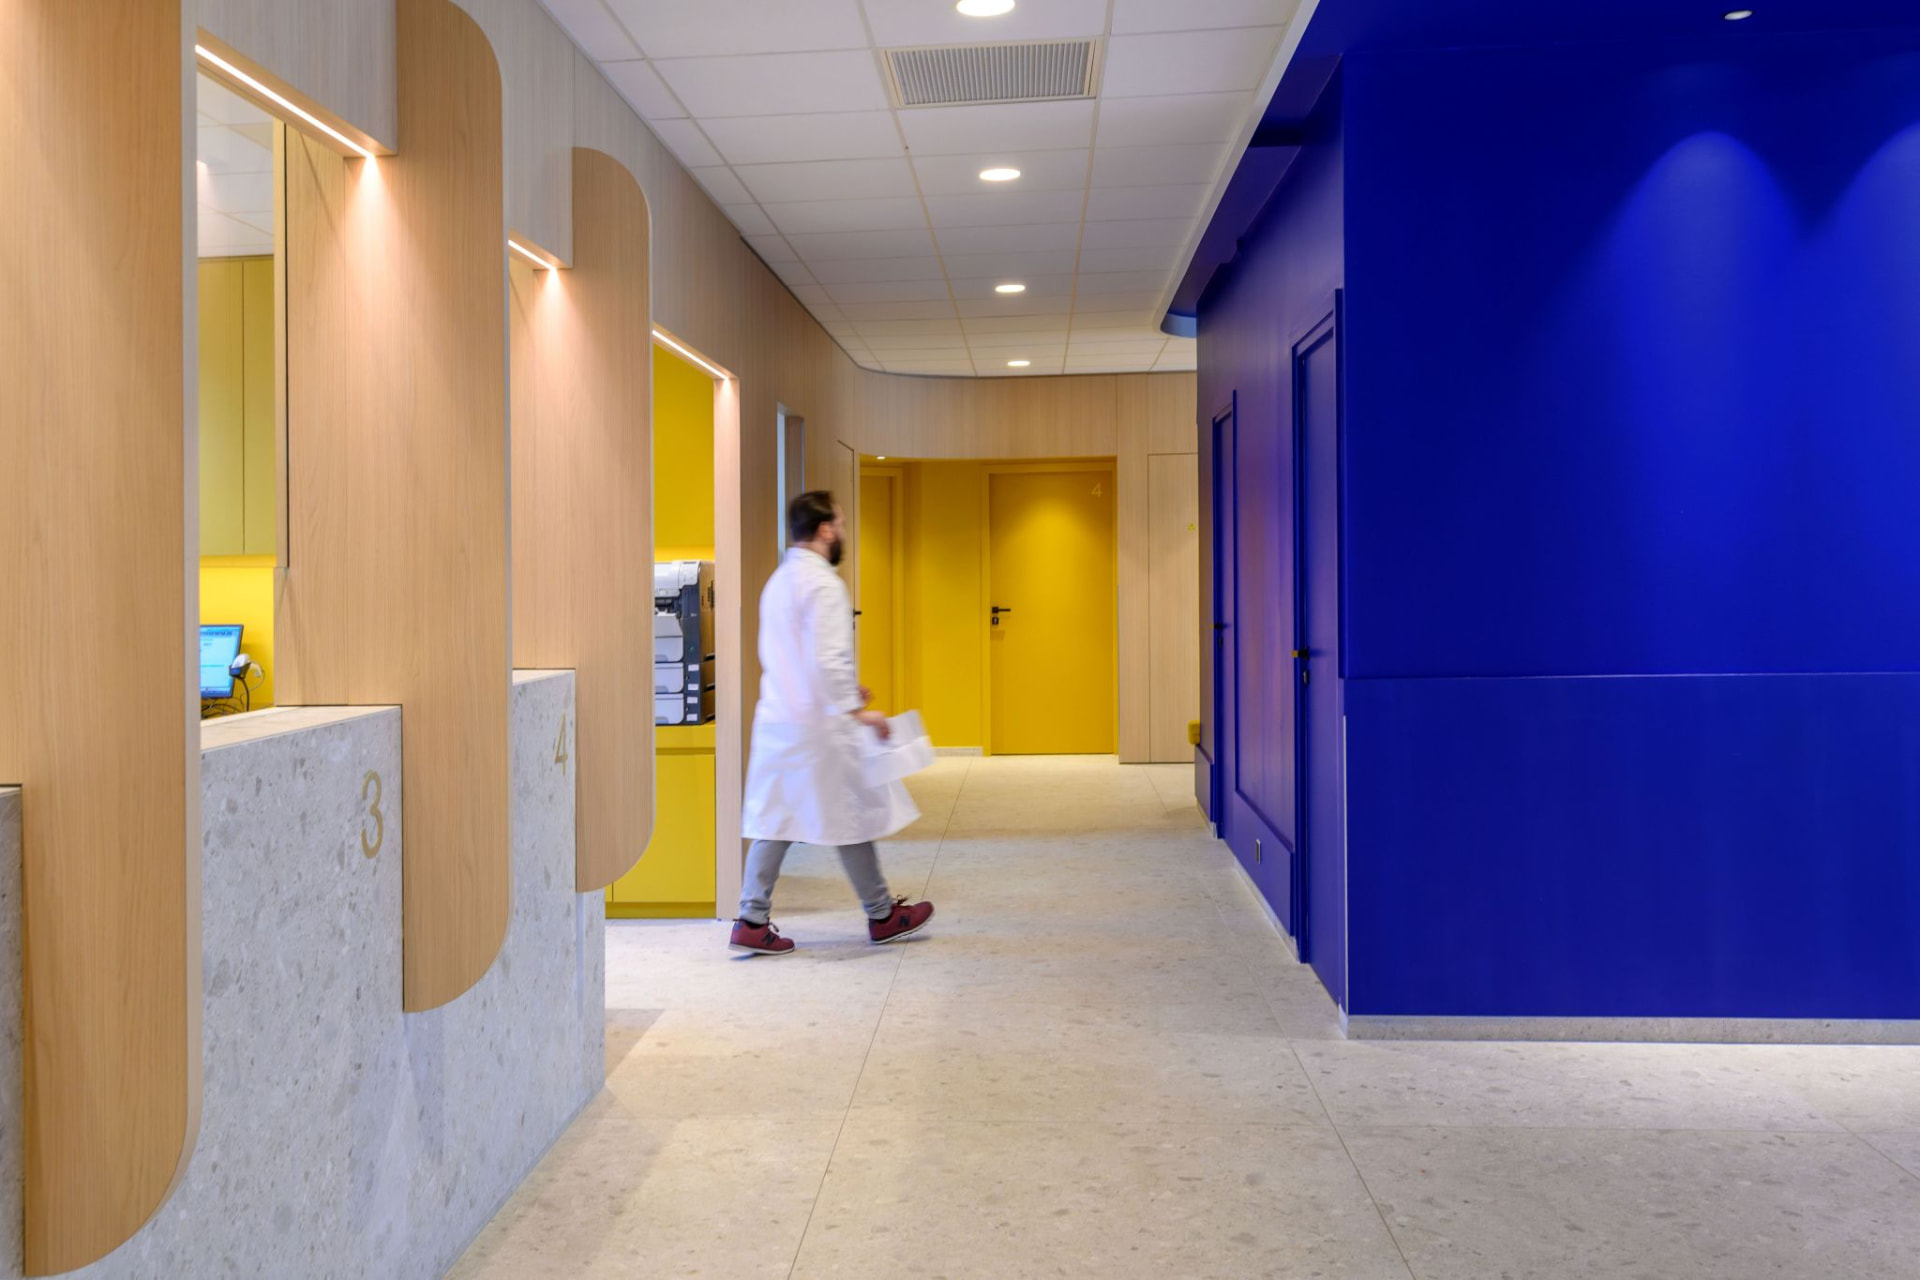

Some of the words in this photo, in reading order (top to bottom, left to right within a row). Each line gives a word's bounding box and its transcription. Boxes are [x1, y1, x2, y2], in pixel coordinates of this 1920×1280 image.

[1091, 482, 1102, 498] 4
[554, 711, 568, 776] 4
[361, 769, 383, 859] 3
